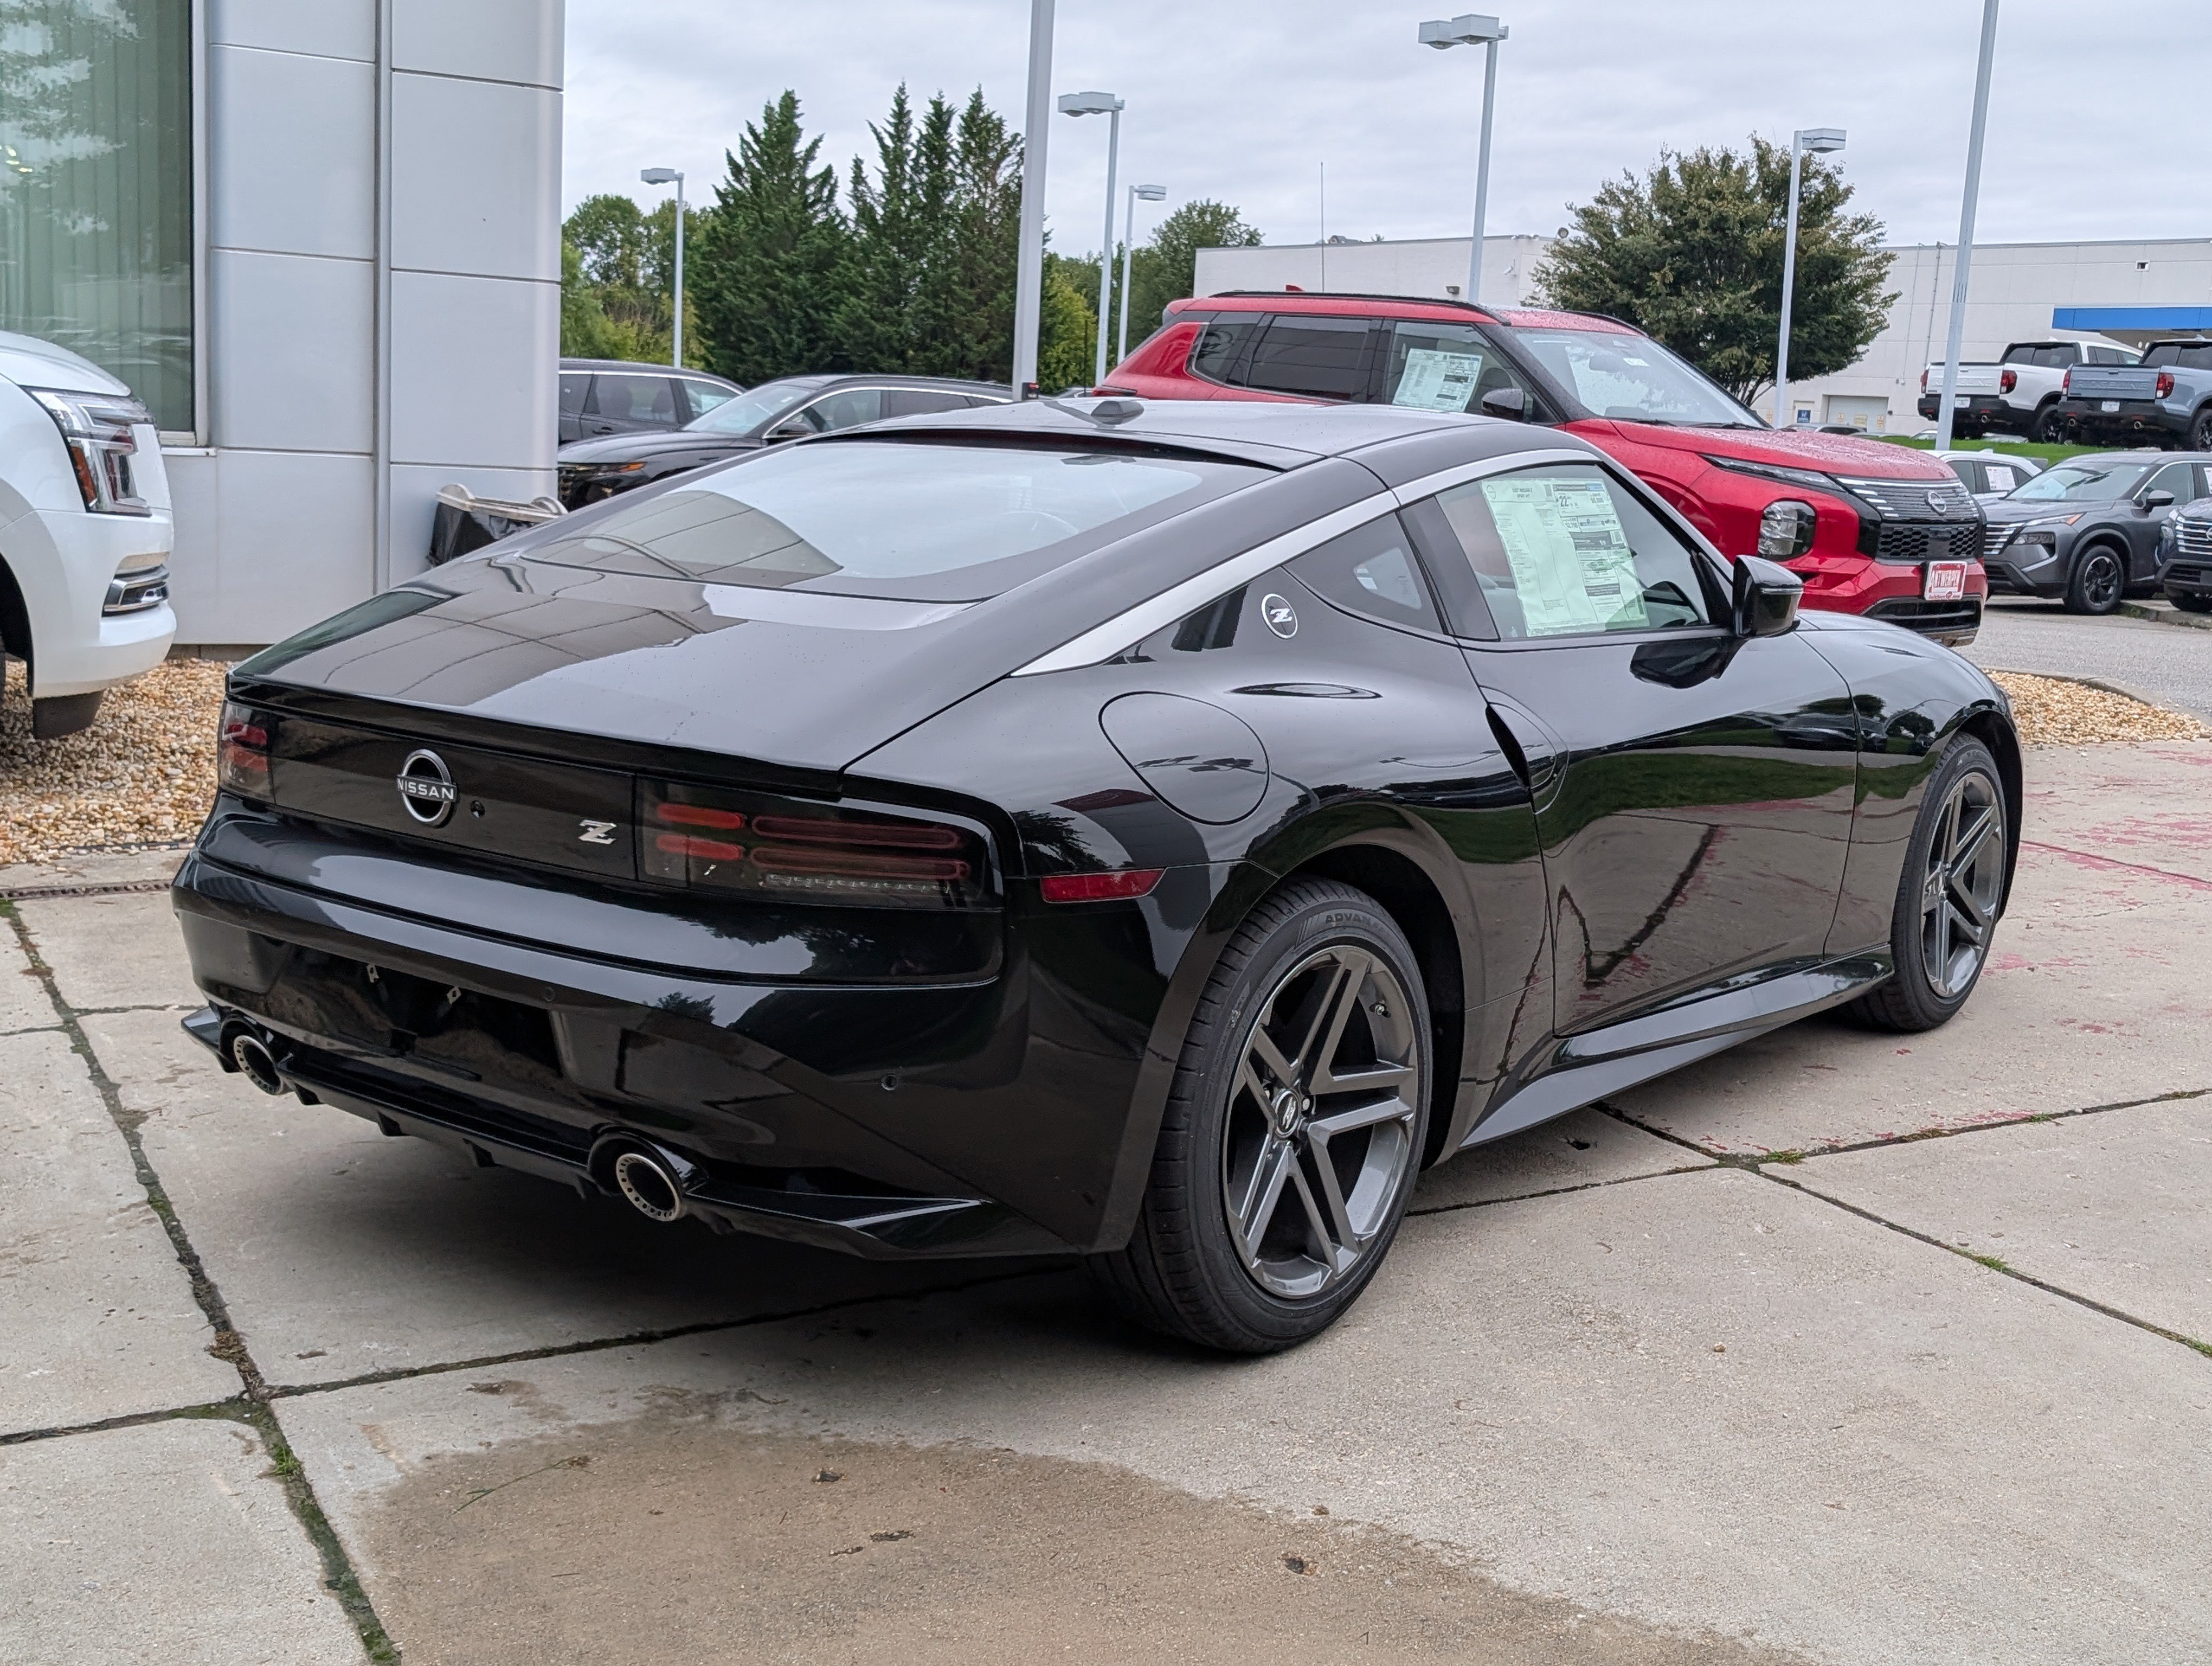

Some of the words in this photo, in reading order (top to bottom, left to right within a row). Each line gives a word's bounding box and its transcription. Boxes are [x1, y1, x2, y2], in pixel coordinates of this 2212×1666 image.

[2075, 380, 2149, 390] RIDGELINE
[1269, 607, 1293, 623] Z
[397, 778, 454, 800] NISSAN
[578, 819, 617, 844] Z
[1325, 912, 1372, 926] ADVAN
